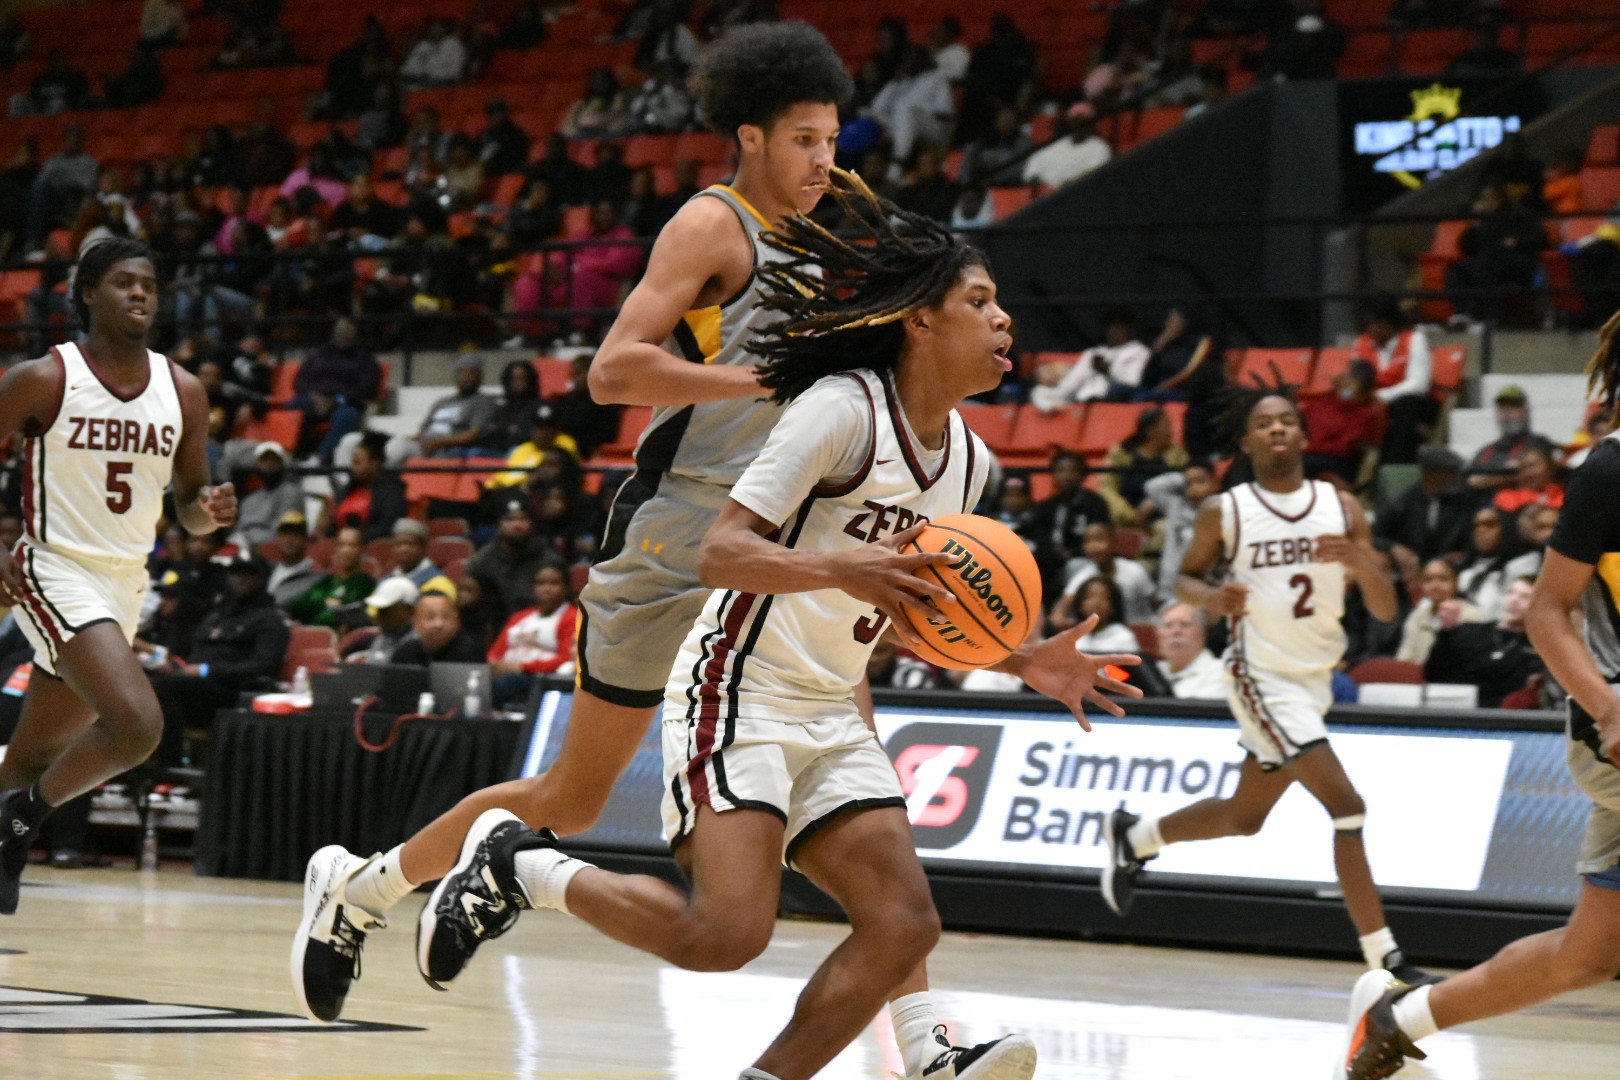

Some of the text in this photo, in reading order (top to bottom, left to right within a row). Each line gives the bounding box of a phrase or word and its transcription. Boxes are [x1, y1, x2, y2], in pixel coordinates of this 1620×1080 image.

[67, 416, 175, 457] ZEBRAS
[106, 461, 132, 514] 5
[1248, 536, 1314, 569] ZEBR
[940, 538, 1013, 628] Wilson
[1289, 573, 1314, 619] 2
[1019, 741, 1242, 798] Simmon
[1003, 795, 1142, 846] Ban
